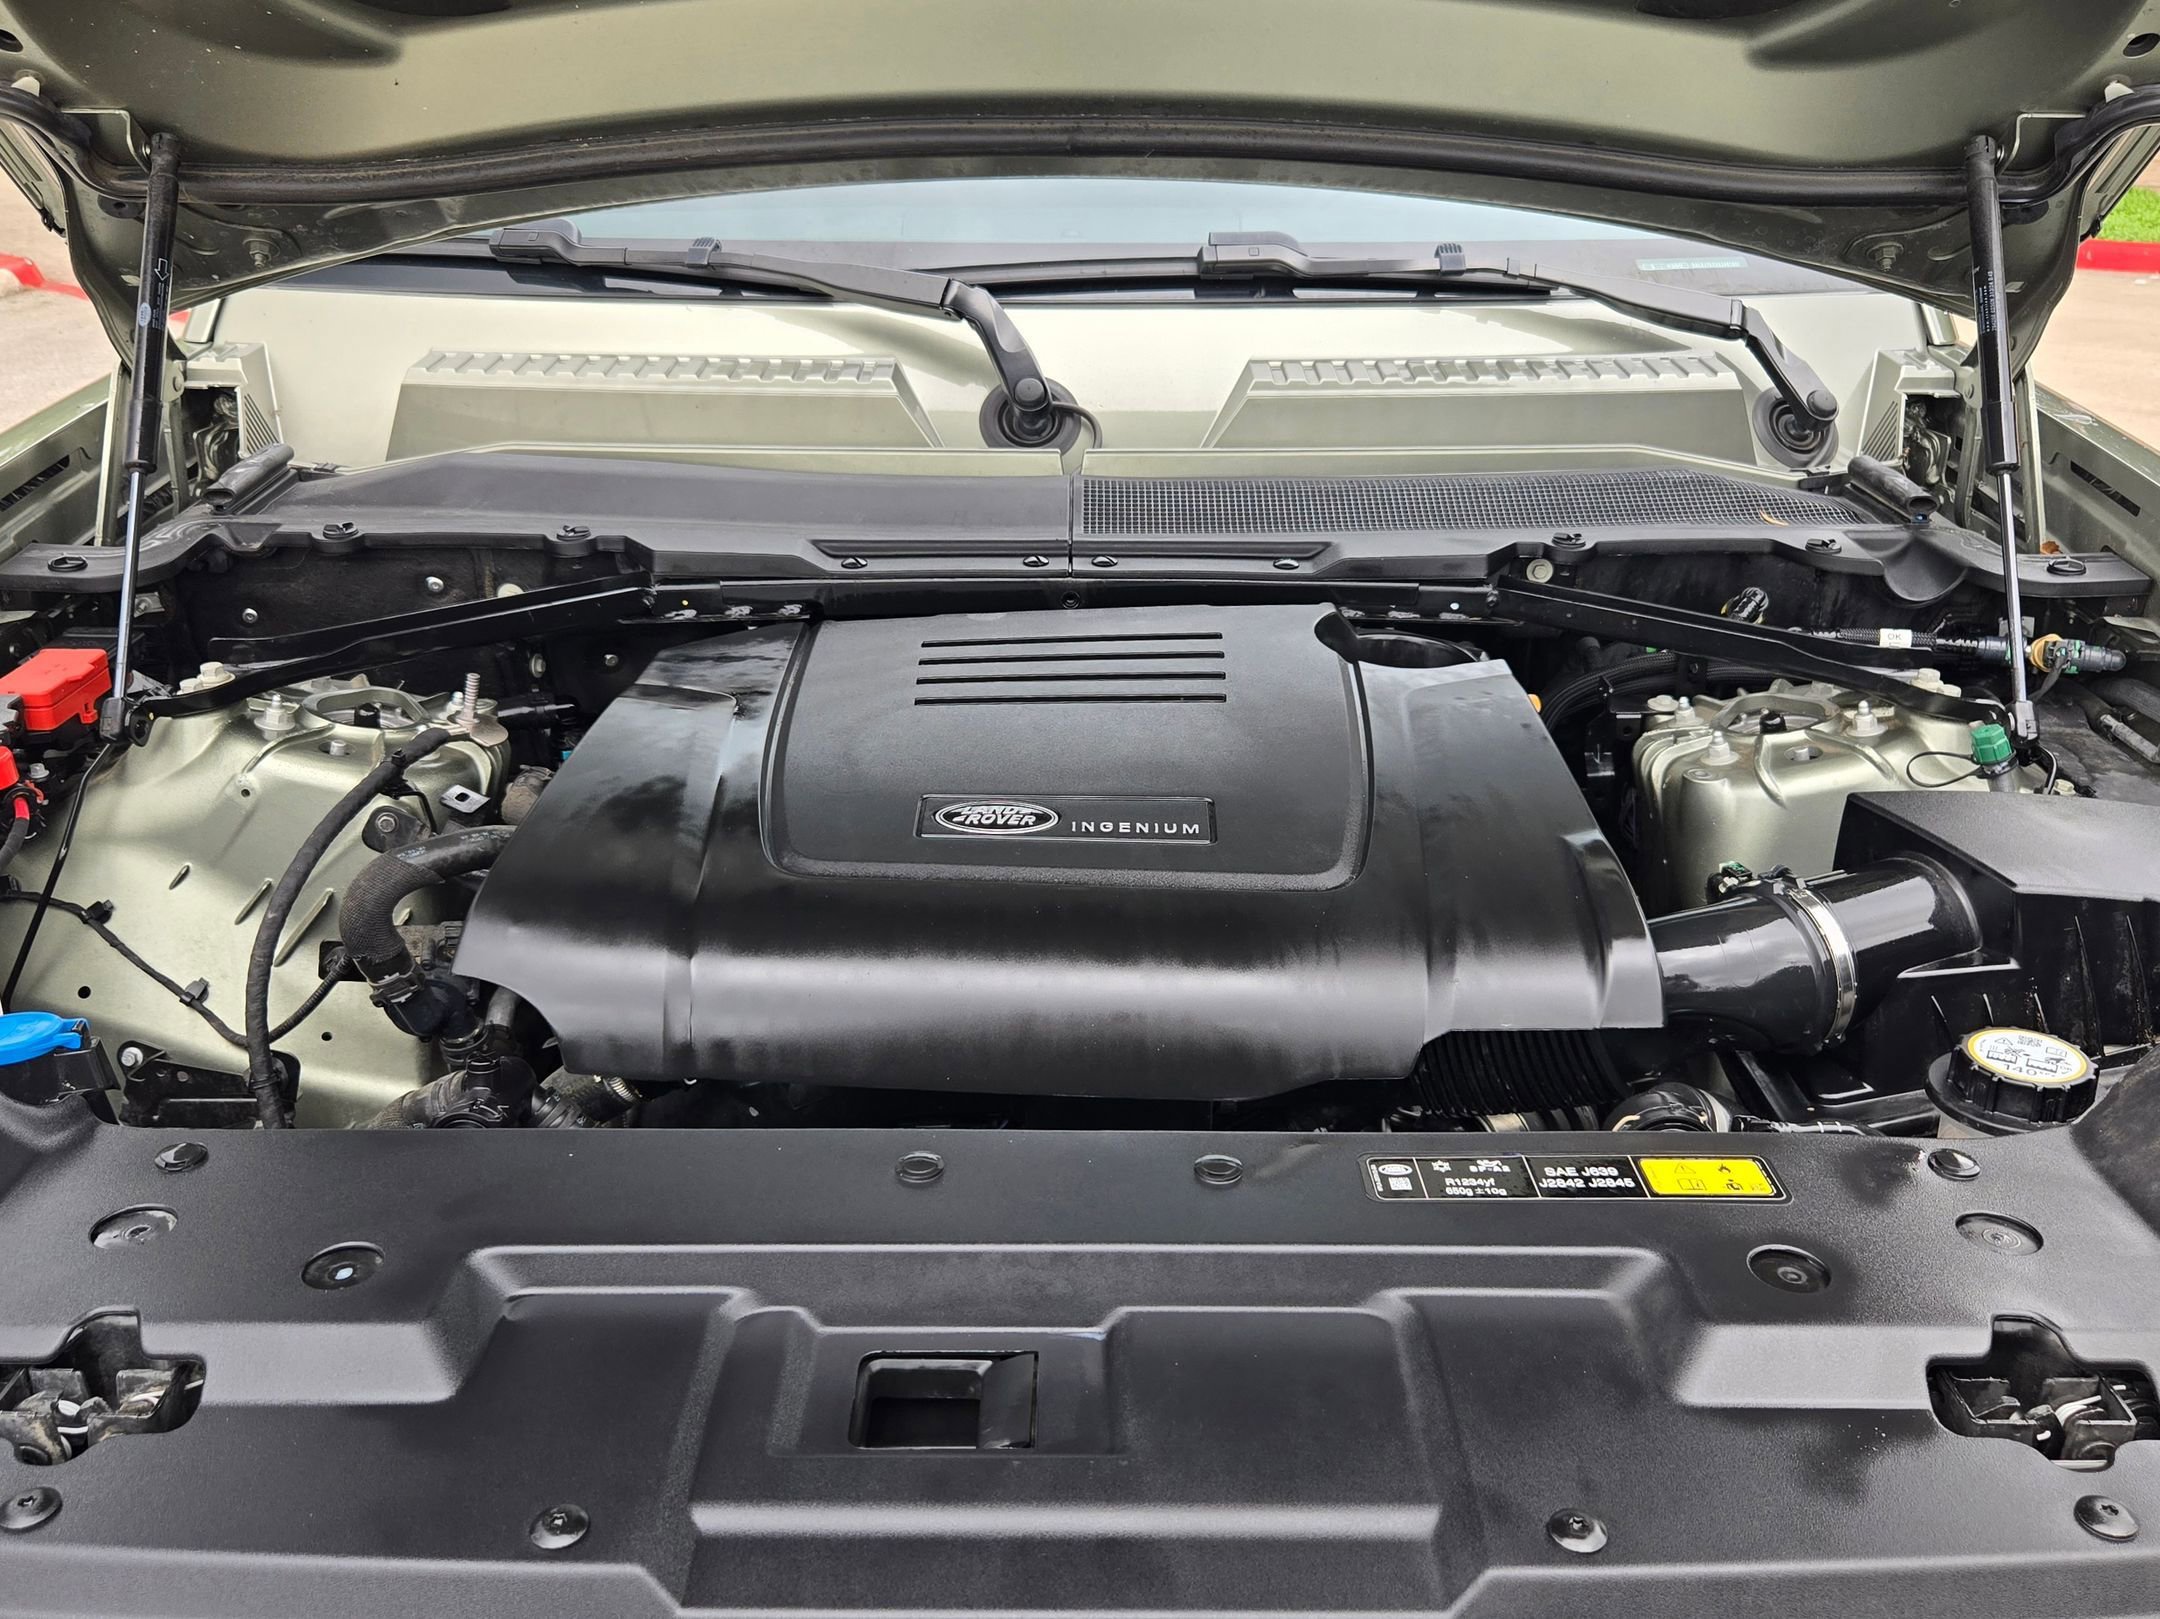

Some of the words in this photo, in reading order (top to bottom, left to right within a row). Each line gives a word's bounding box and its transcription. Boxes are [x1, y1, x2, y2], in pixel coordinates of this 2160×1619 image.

[961, 806, 1019, 815] LAND
[964, 814, 1036, 825] ROVER
[1071, 821, 1201, 834] INGENIUM
[1544, 1166, 1579, 1177] SAE
[1581, 1166, 1619, 1177] J639
[1444, 1177, 1495, 1187] R1234yf
[1538, 1178, 1586, 1188] J2842
[1588, 1177, 1636, 1188] J2845
